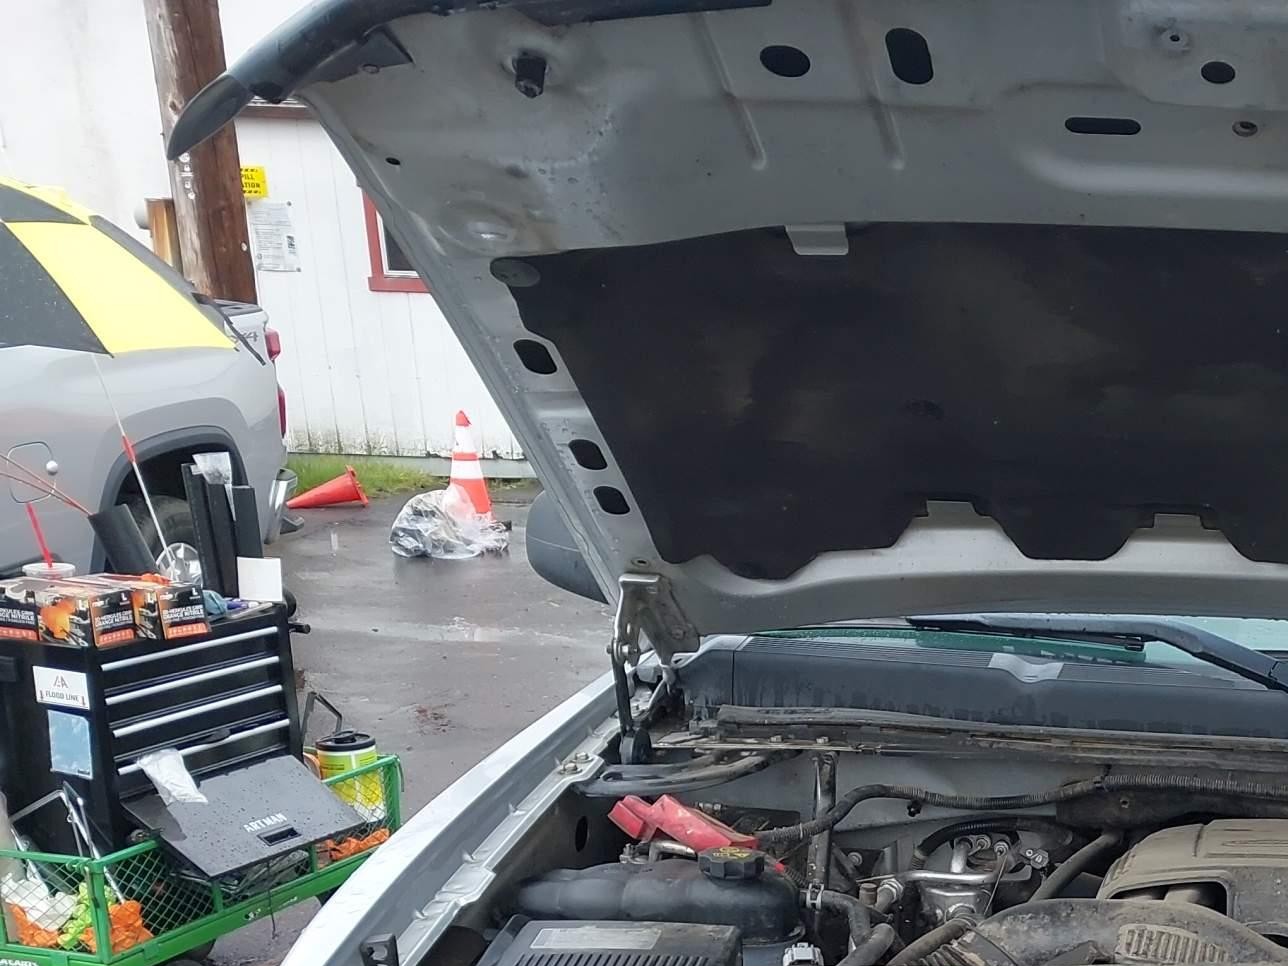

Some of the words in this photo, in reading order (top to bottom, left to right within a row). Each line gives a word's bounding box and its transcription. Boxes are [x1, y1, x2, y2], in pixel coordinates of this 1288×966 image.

[45, 690, 65, 700] FLOOD
[65, 694, 80, 703] LINE
[243, 812, 288, 832] ARTMAN
